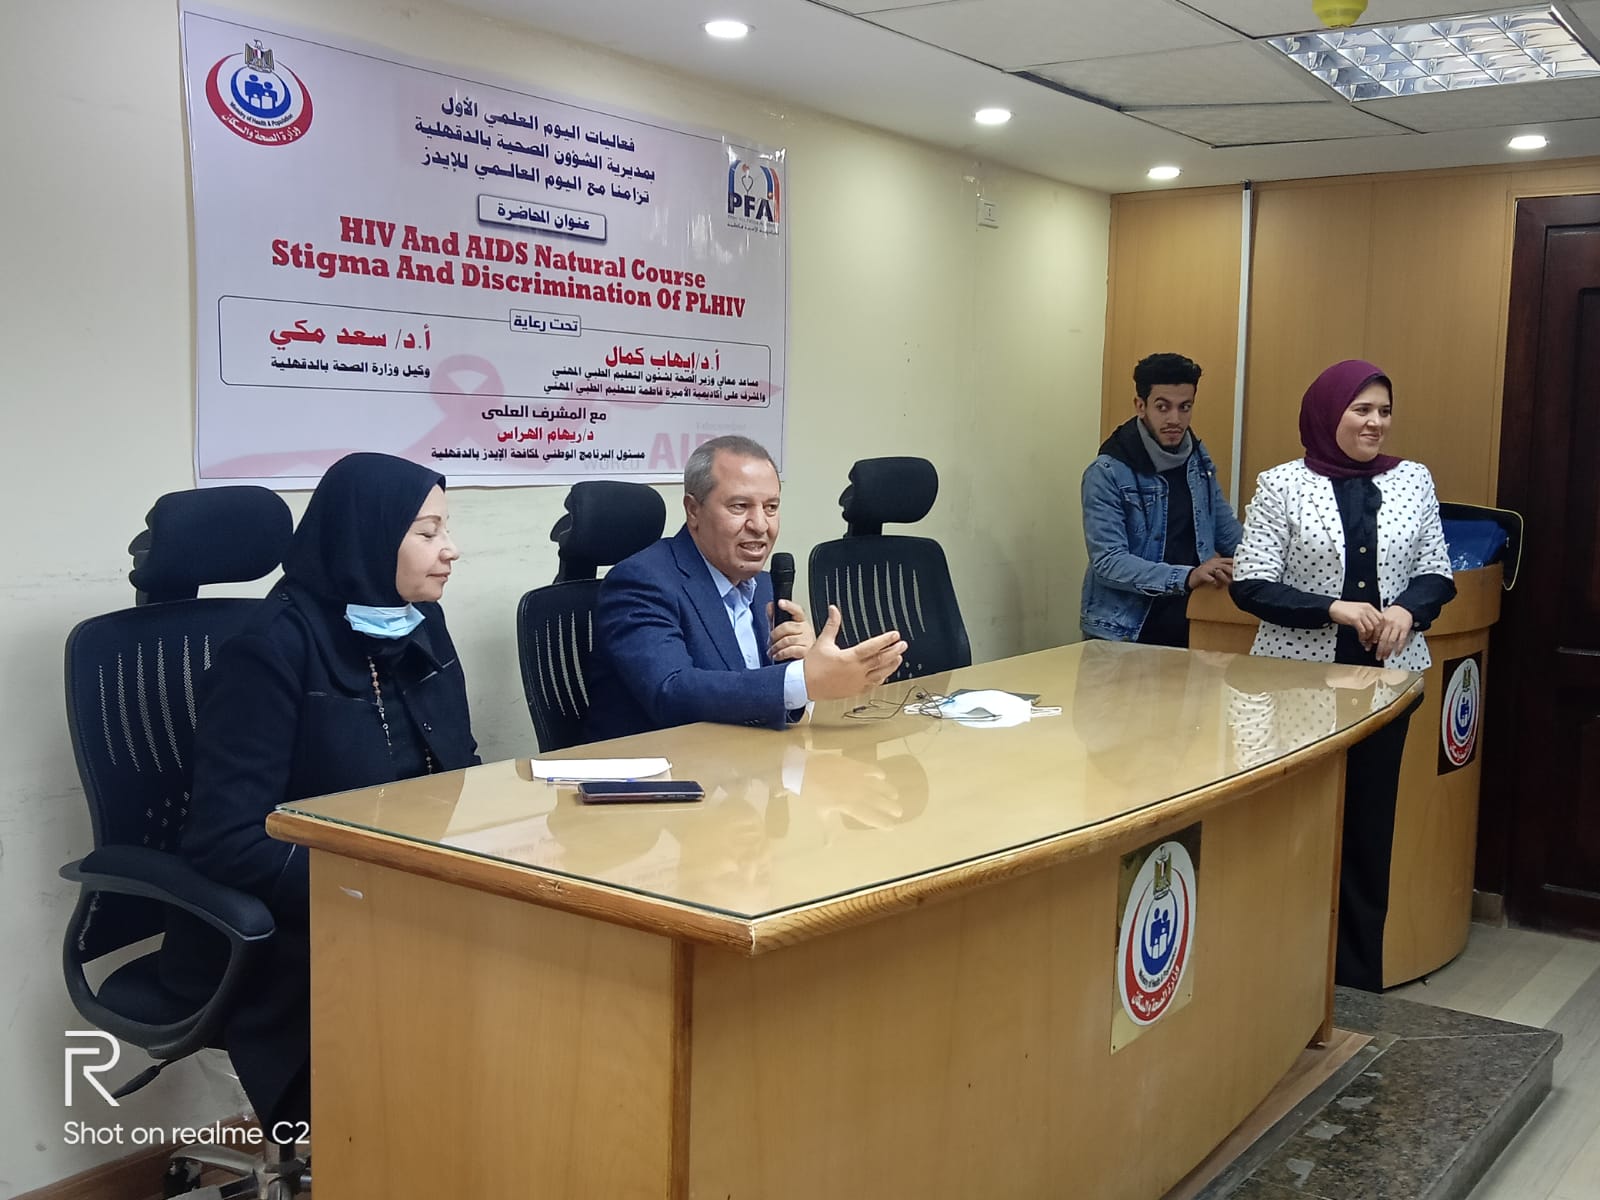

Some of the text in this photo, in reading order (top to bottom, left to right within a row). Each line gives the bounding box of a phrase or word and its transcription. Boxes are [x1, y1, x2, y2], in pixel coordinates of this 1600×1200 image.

[441, 96, 635, 152] فعاليات اليوم العلمي الأول
[415, 116, 656, 183] بمديرية الشؤون الصحية بالدقهلية
[475, 161, 540, 183] العالمي
[545, 173, 581, 192] اليوم
[587, 180, 605, 196] مع
[611, 182, 650, 205] تزامنا
[497, 203, 590, 231] عنوان المحاضرة
[727, 192, 774, 223] PFA
[340, 216, 706, 289] HIV And AIDS Natural Course
[272, 239, 746, 318] Stigma And Discrimination Of PLHIV
[513, 315, 579, 332] تحت رعاية
[269, 319, 326, 351] مكي
[337, 328, 387, 347] سعد
[605, 345, 644, 367] كمال
[271, 356, 431, 377] وكيل وزارة الصحة بالدقهلية
[532, 407, 586, 421] المشرف
[589, 411, 607, 424] مع
[497, 427, 542, 443] الهراس
[431, 447, 480, 461] بالدقهلية
[483, 448, 508, 461] الإيدز
[511, 447, 539, 459] لمكافحة
[542, 448, 577, 463] الوطني
[578, 448, 614, 461] البرنامج
